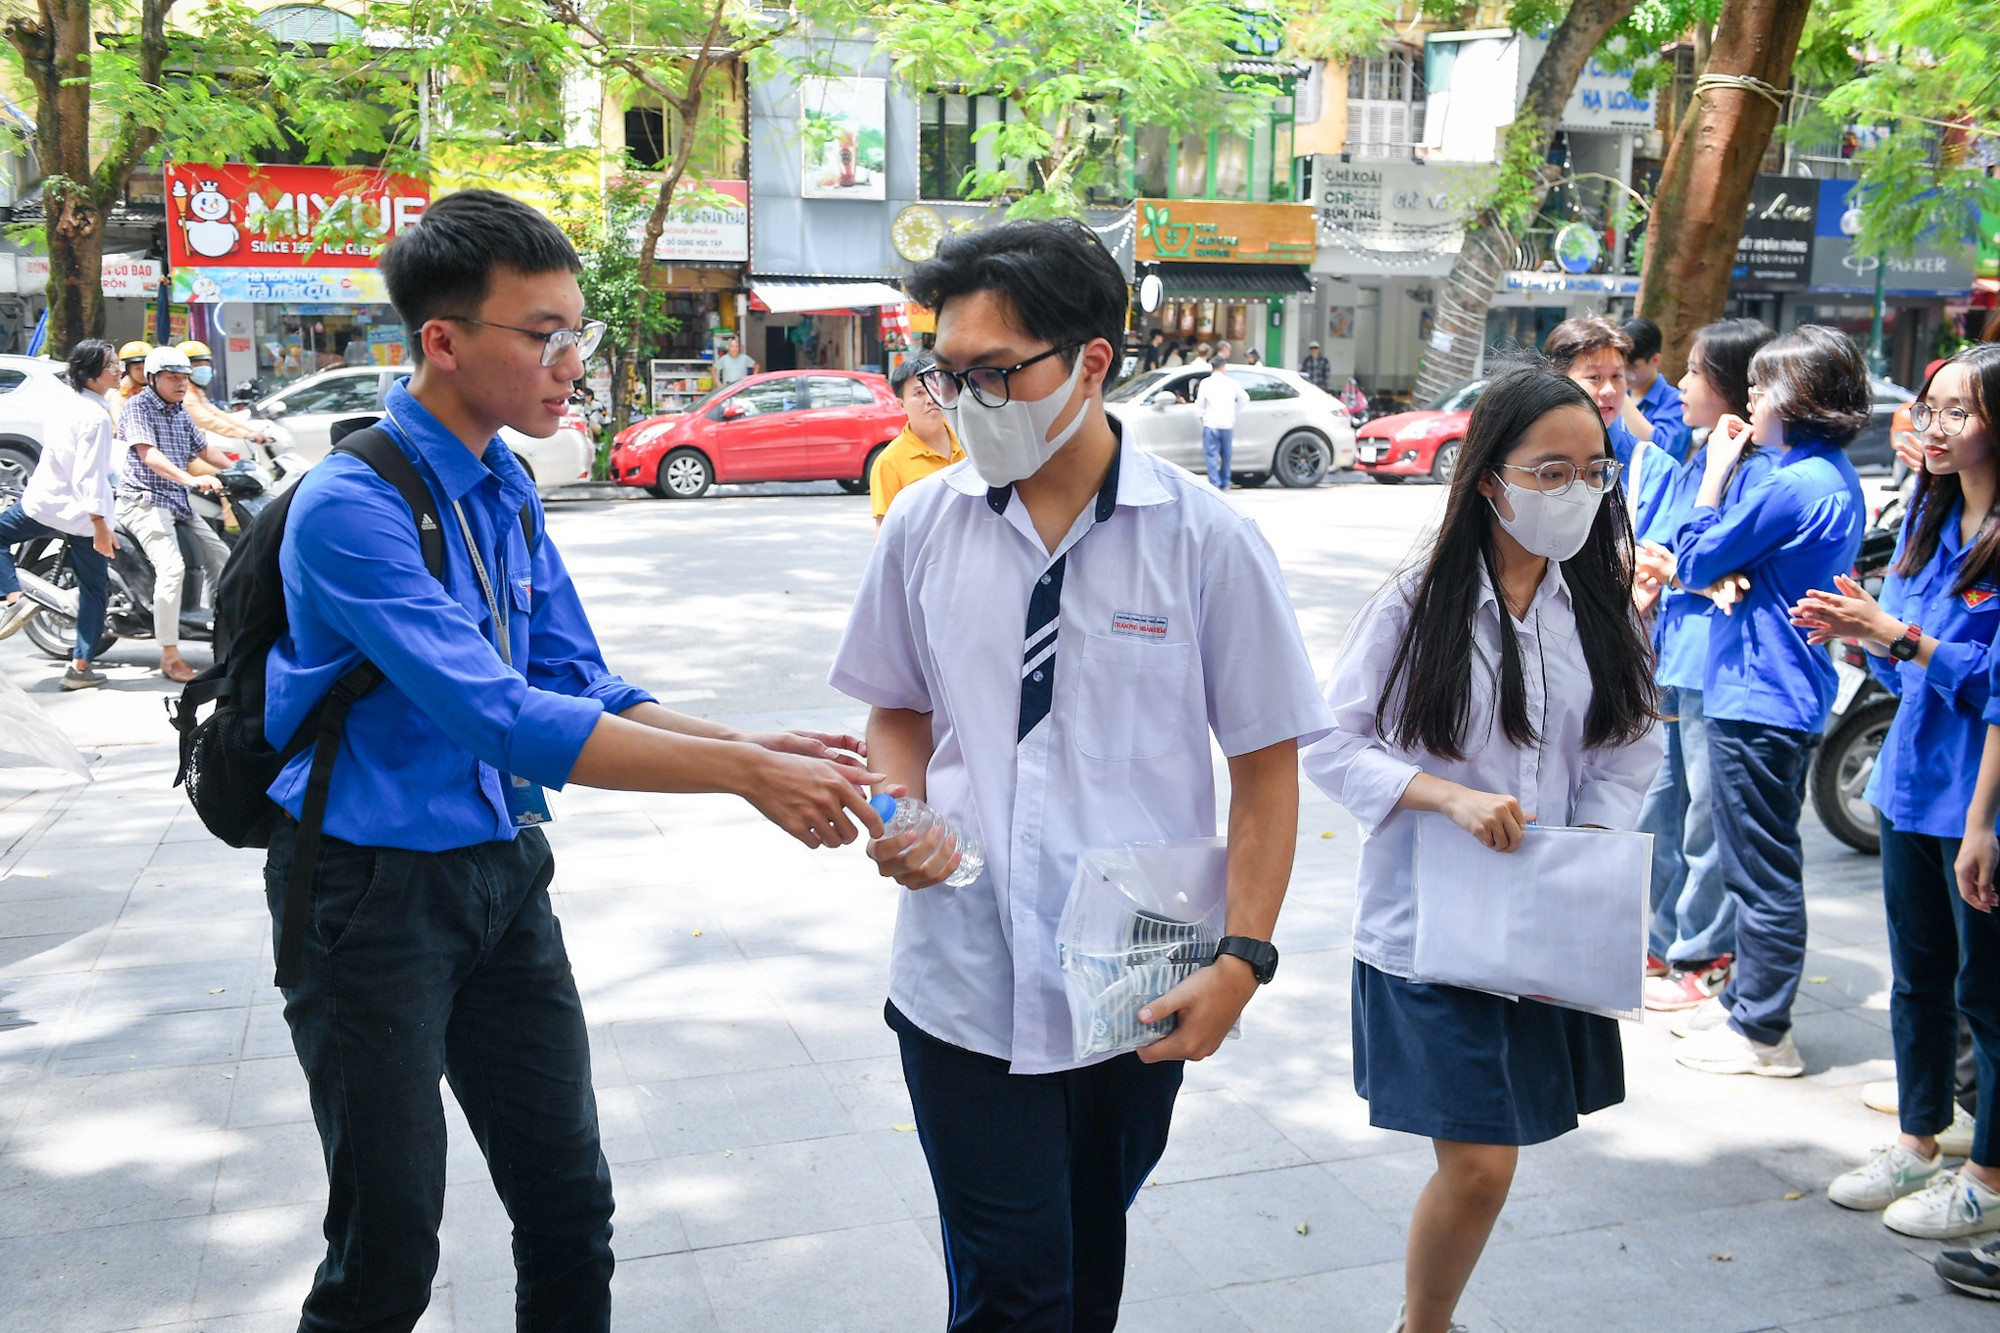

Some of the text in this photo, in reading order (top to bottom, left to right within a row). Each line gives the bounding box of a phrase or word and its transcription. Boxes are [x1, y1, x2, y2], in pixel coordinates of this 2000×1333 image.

[1582, 89, 1602, 113] HẠ
[248, 191, 426, 237] MIXUE
[251, 240, 290, 254] SINCE
[103, 277, 127, 290] RỘN
[1124, 964, 1153, 995] MY
